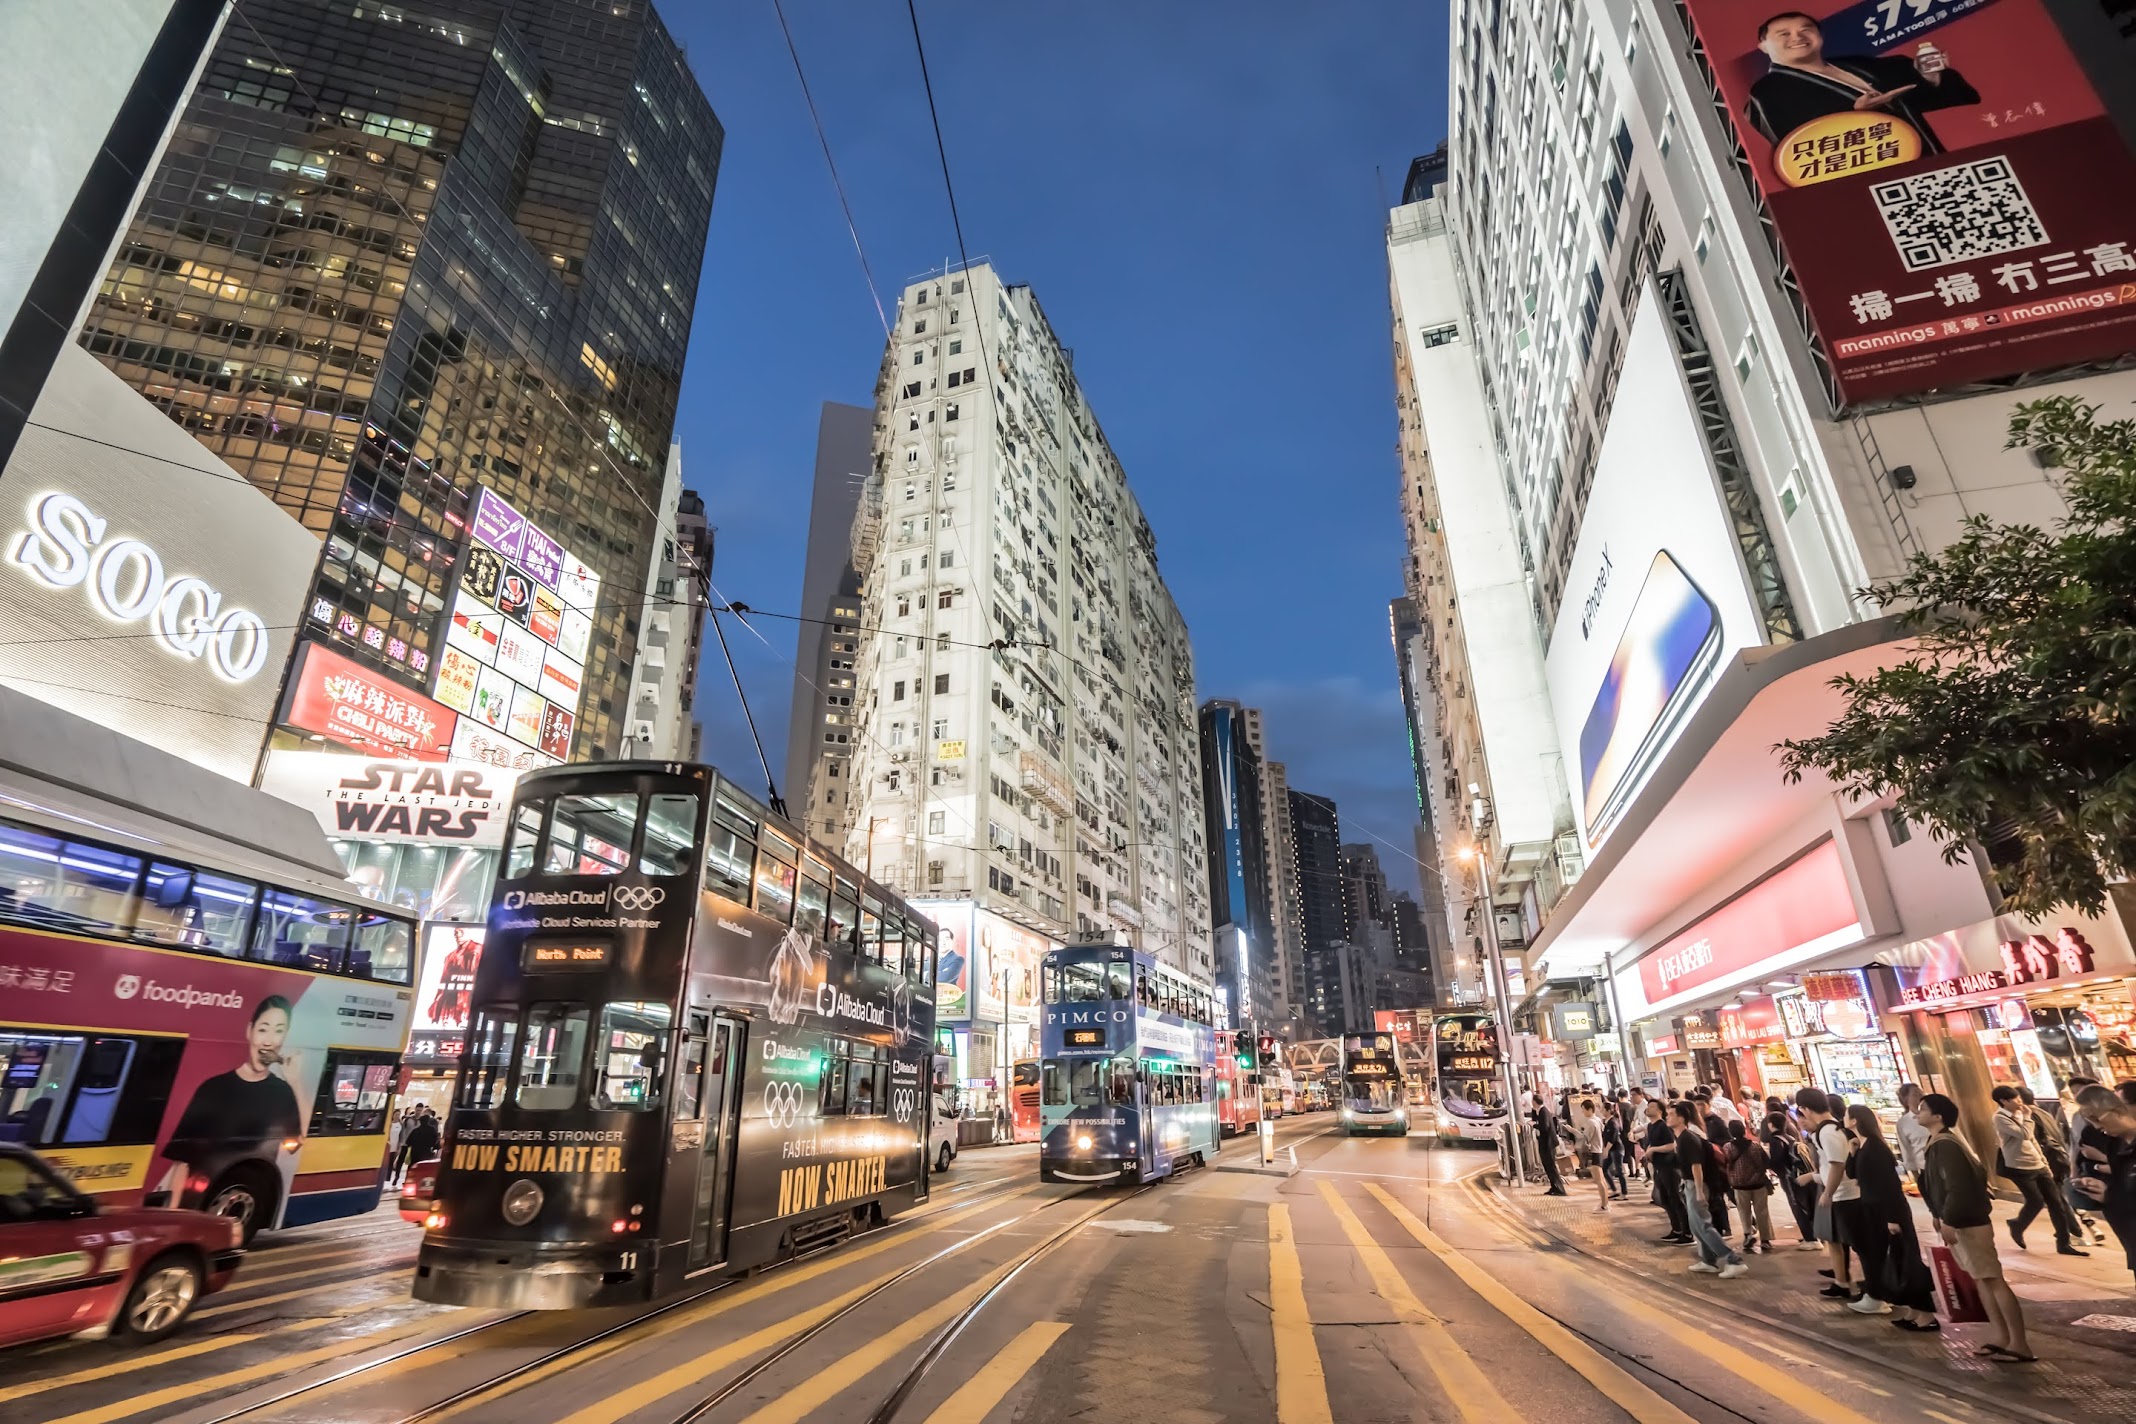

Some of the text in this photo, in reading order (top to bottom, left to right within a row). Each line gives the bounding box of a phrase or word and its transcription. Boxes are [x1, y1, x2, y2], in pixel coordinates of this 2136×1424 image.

[1863, 0, 1954, 37] $79
[1799, 139, 1900, 180] 才是正貨
[1849, 241, 2136, 325] 掃一掃 冇三高
[1840, 325, 1936, 354] mannings
[2011, 291, 2116, 321] mannings
[528, 527, 549, 556] THAI
[10, 492, 270, 681] SOGO
[1584, 541, 1614, 633] iPhone X
[340, 680, 428, 732] 麻辣派對
[374, 720, 420, 750] PARTY
[338, 763, 494, 799] STAR
[664, 763, 683, 776] 11
[326, 789, 502, 811] THE LAST JEDI
[335, 800, 490, 839] WARS
[525, 889, 607, 906] Alibaba Cloud
[541, 916, 571, 928] Cloud
[571, 916, 618, 929] Services
[618, 917, 661, 930] Partner
[1078, 931, 1106, 943] 154
[1046, 954, 1058, 963] 154
[1110, 951, 1124, 960] 154
[142, 980, 244, 1010] foodpanda
[1902, 970, 1999, 1005] BEE CHENG HIANG
[1047, 1010, 1128, 1025] PIMCO
[1480, 1057, 1494, 1069] 112
[457, 1128, 627, 1142] FASTER. HIGHER. STRONGER.
[452, 1144, 627, 1173] NOW SMARTER.
[1122, 1161, 1137, 1170] 154
[777, 1155, 887, 1217] NOW SMARTER.
[619, 1251, 638, 1270] 11
